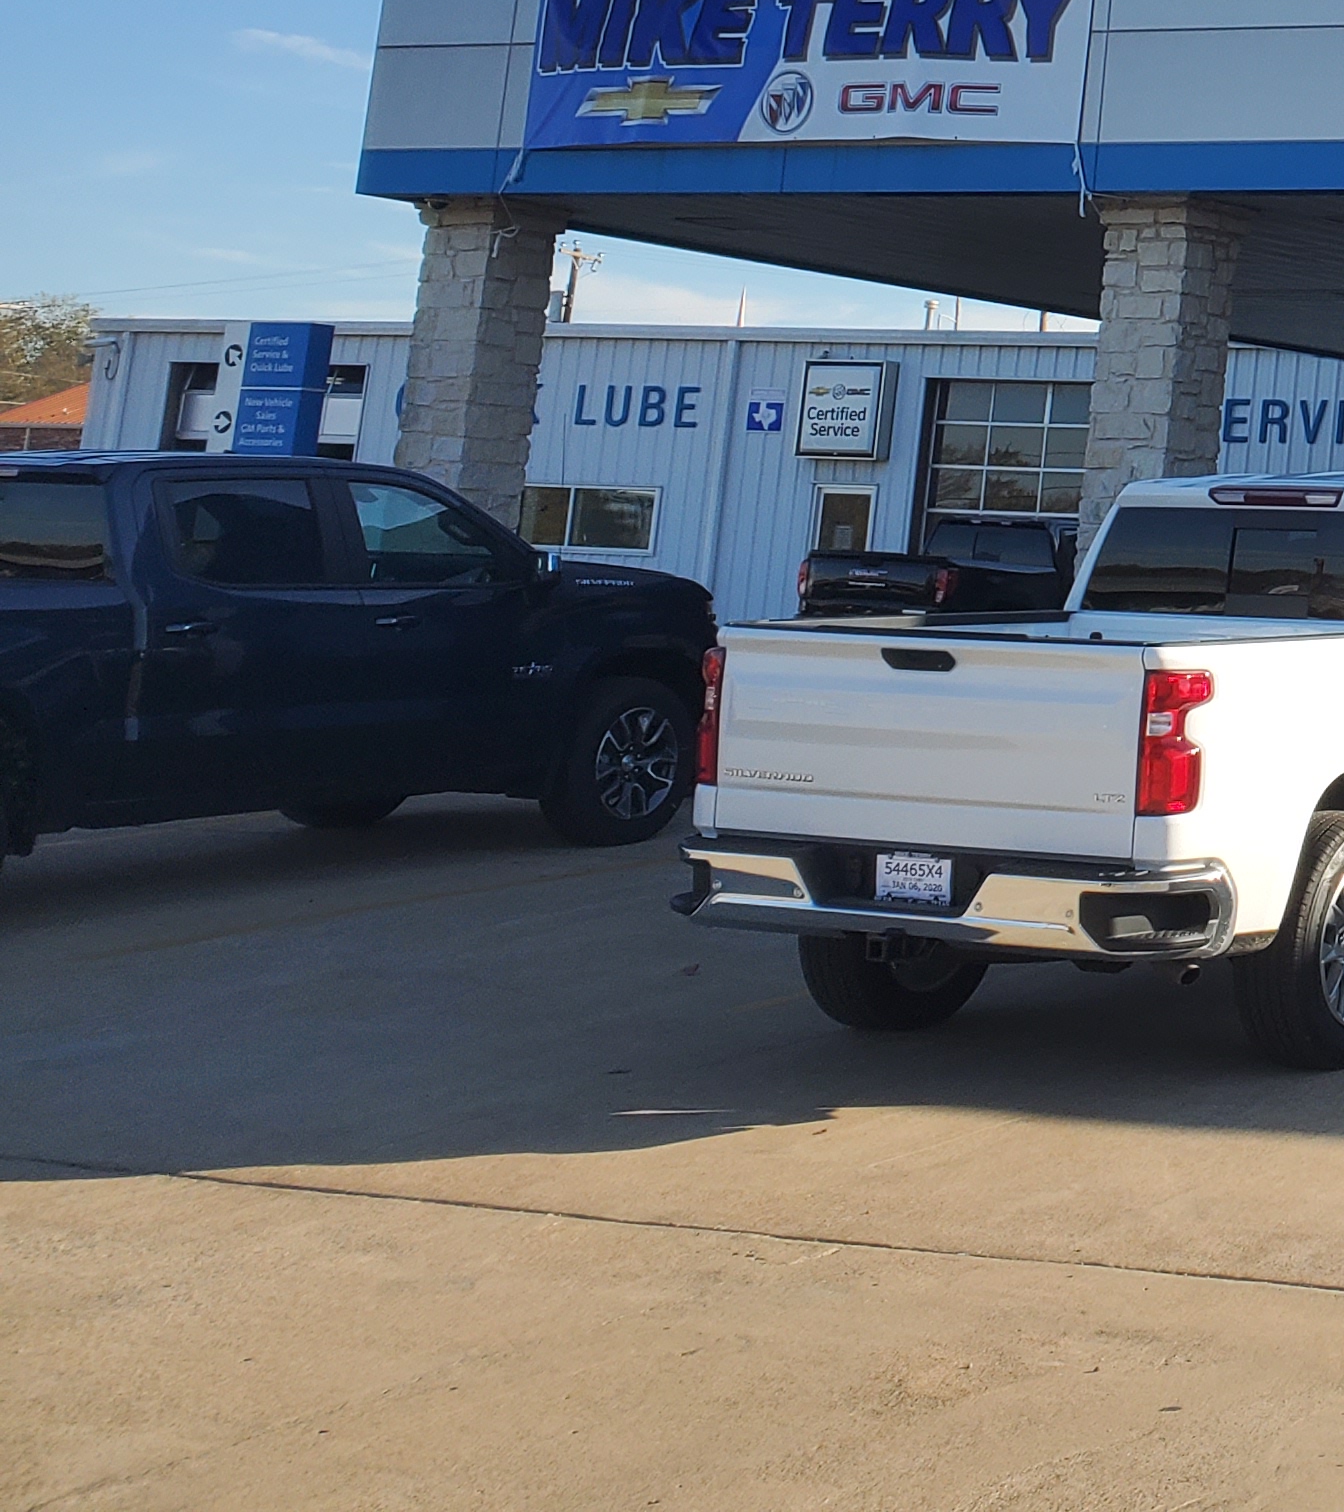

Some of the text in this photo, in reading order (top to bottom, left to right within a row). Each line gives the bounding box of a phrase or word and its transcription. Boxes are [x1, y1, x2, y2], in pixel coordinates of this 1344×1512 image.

[837, 81, 1001, 116] GMC
[255, 336, 290, 346] Certified
[252, 350, 289, 359] Service &
[250, 362, 294, 373] Quick Lube
[244, 397, 293, 407] New Vehicle
[574, 384, 702, 428] LUBE
[256, 411, 277, 420] Sales
[807, 407, 867, 421] Certified
[241, 424, 256, 434] GM
[256, 424, 276, 434] Parts
[809, 423, 860, 437] Service
[238, 438, 283, 446] Accessories
[723, 767, 814, 784] SILVERADO
[884, 861, 943, 879] 54465X4
[891, 880, 943, 893] JAN 06, 2020
